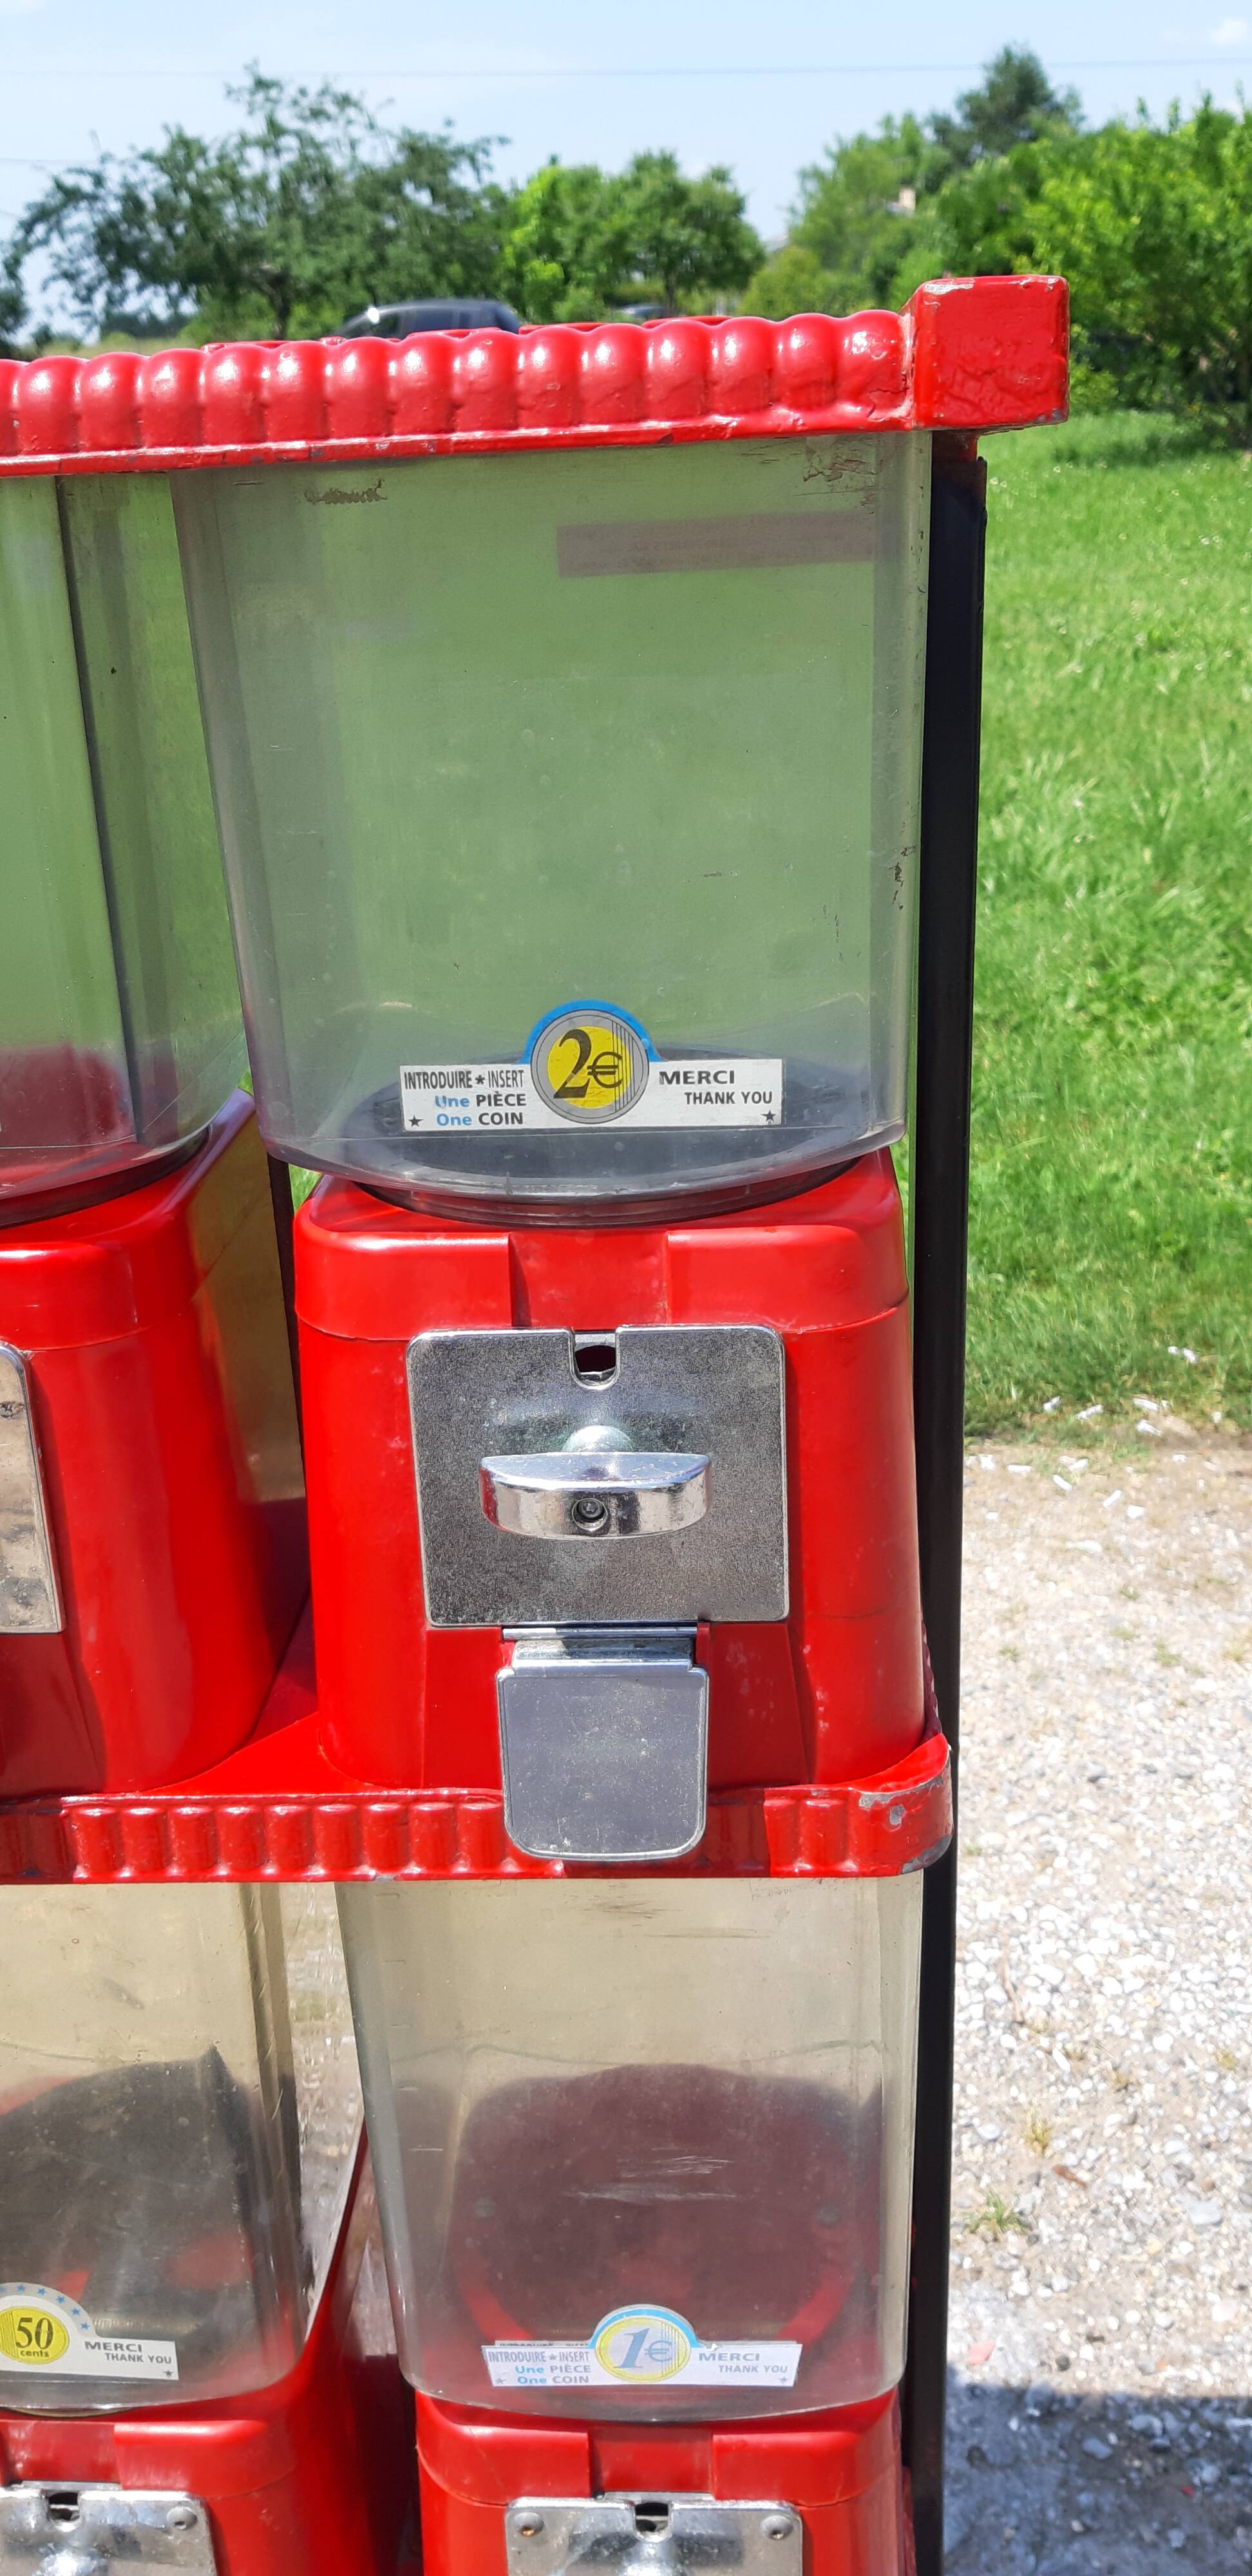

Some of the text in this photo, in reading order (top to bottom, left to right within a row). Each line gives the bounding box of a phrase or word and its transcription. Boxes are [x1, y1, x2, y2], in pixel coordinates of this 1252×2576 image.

[553, 1028, 623, 1099] 2€
[404, 1070, 524, 1090] INTRODUIRE INSERT
[659, 1070, 735, 1085] MERCI
[434, 1091, 526, 1108] Une PIÈCE
[685, 1091, 772, 1104] THANK YOU
[436, 1112, 524, 1126] One COIN
[15, 2316, 54, 2350] 50
[84, 2340, 143, 2353] MERCI
[614, 2327, 672, 2369] 1€
[20, 2349, 50, 2358] cents
[104, 2352, 172, 2364] THANK YOU
[488, 2351, 589, 2363] INTRODUIRE INSERT
[699, 2353, 760, 2362] MERCI
[515, 2362, 591, 2374] Une PIÈCE
[719, 2364, 788, 2373] THANK YOU
[552, 2375, 589, 2383] COIN
